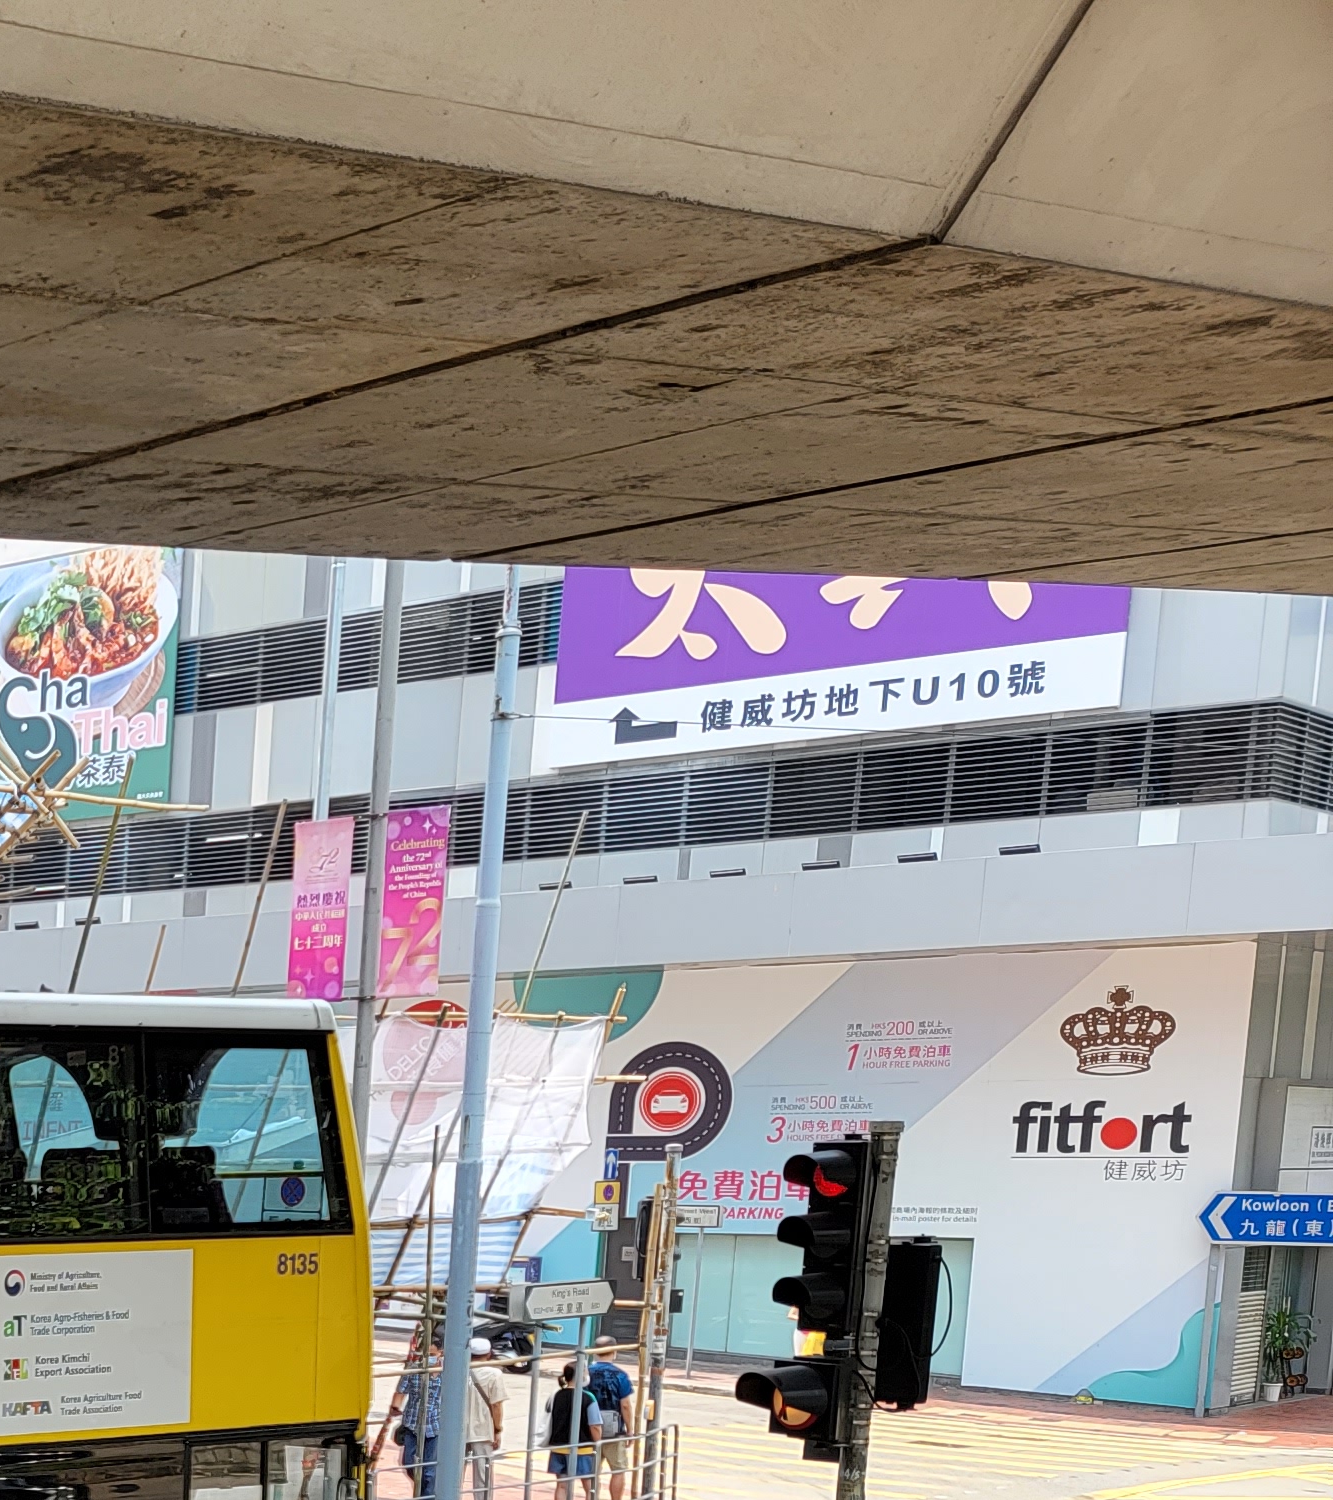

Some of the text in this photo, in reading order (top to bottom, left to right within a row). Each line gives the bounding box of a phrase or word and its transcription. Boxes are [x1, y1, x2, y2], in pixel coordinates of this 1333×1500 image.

[701, 660, 1047, 734] 健威坊地下U10號
[75, 701, 166, 754] Thai
[391, 837, 445, 851] Celebrating
[403, 853, 415, 862] the
[389, 860, 442, 873] Anniversary of
[848, 1043, 951, 1071] 1 小時免費泊車
[863, 1059, 951, 1069] HOUR FREE PARKING
[766, 1116, 786, 1143] 3
[1103, 1160, 1187, 1181] 健威坊
[1241, 1198, 1309, 1212] Kowloon
[277, 1253, 319, 1275] 8135
[30, 1272, 56, 1282] Ministry
[30, 1284, 45, 1292] Food
[47, 1283, 58, 1291] and
[551, 1286, 590, 1299] King's Road
[30, 1313, 52, 1323] Korea
[53, 1311, 105, 1325] Agro-Fisheries
[111, 1309, 130, 1319] Food
[3, 1314, 28, 1338] aT
[30, 1324, 95, 1336] Trade Corporation
[35, 1353, 90, 1365] Korea Kimchi
[35, 1367, 62, 1379] Export
[64, 1364, 111, 1375] Association
[61, 1390, 142, 1404] Korea Agriculture Food
[2, 1401, 52, 1417] KAFTA
[61, 1403, 123, 1416] Trade Association
